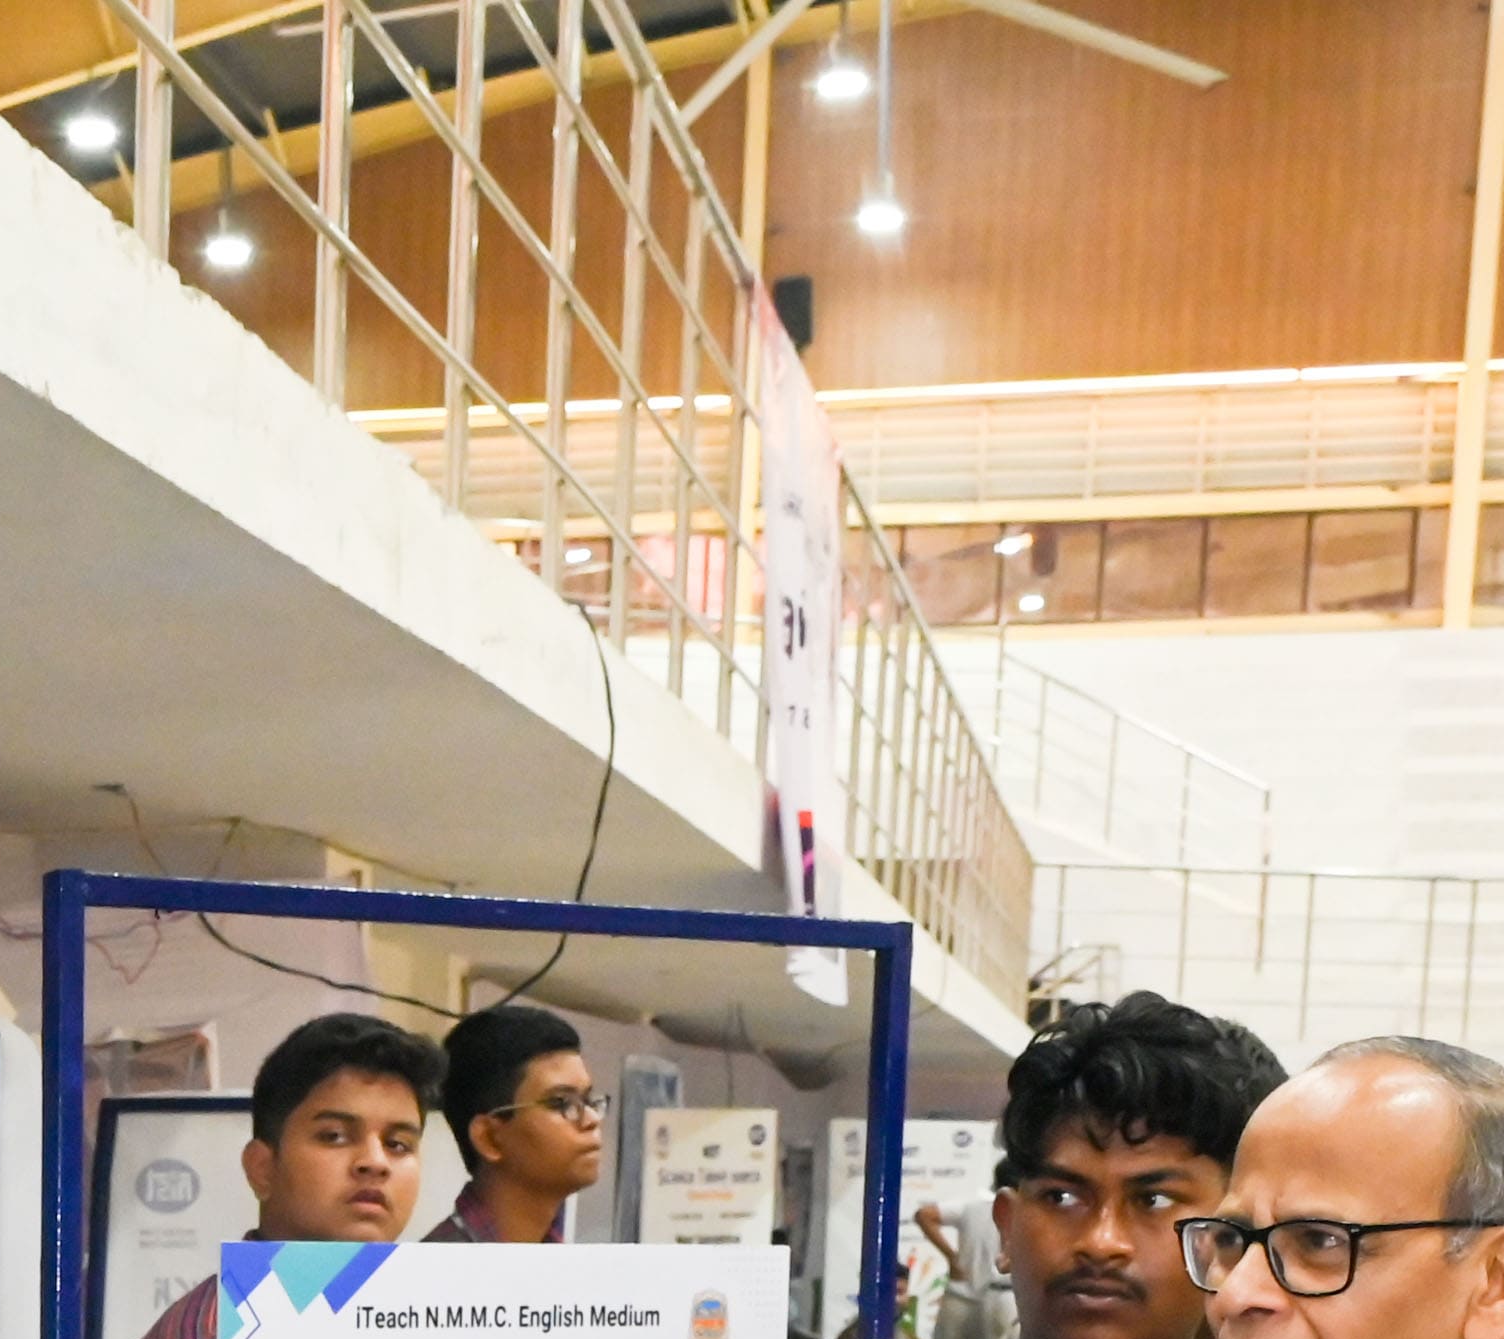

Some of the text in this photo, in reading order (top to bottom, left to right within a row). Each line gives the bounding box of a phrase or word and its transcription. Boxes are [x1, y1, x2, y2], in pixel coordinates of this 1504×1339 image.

[356, 1304, 660, 1333] iTeach N.M.M.C. English Medium
